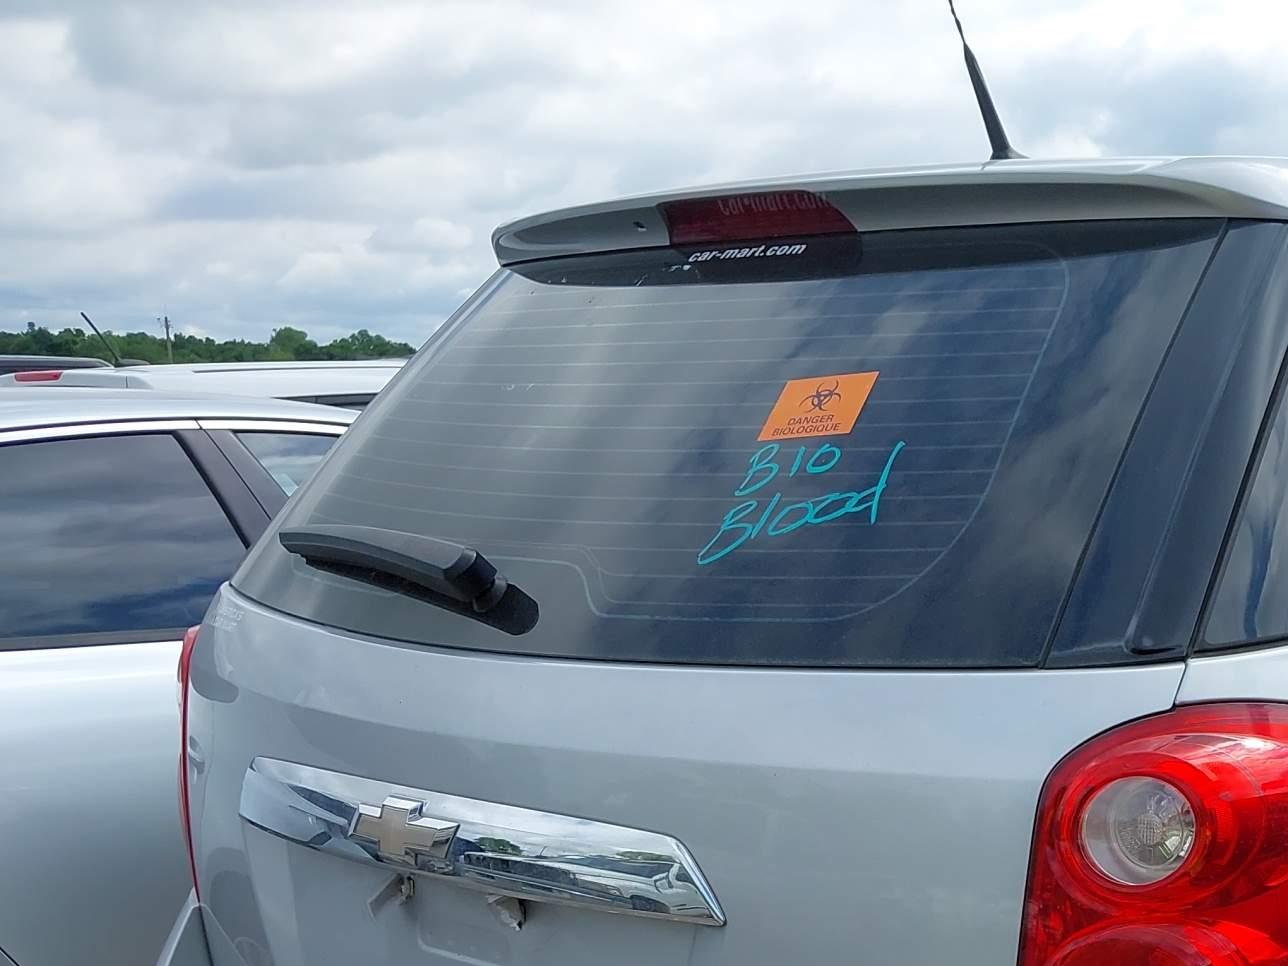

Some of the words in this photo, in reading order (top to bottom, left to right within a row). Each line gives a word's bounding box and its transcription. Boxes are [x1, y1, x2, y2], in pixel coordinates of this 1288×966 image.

[687, 243, 807, 263] car-mart.com
[787, 414, 834, 427] DANGER
[771, 422, 841, 437] BIOLOGIQUE
[697, 440, 907, 565] Blood
